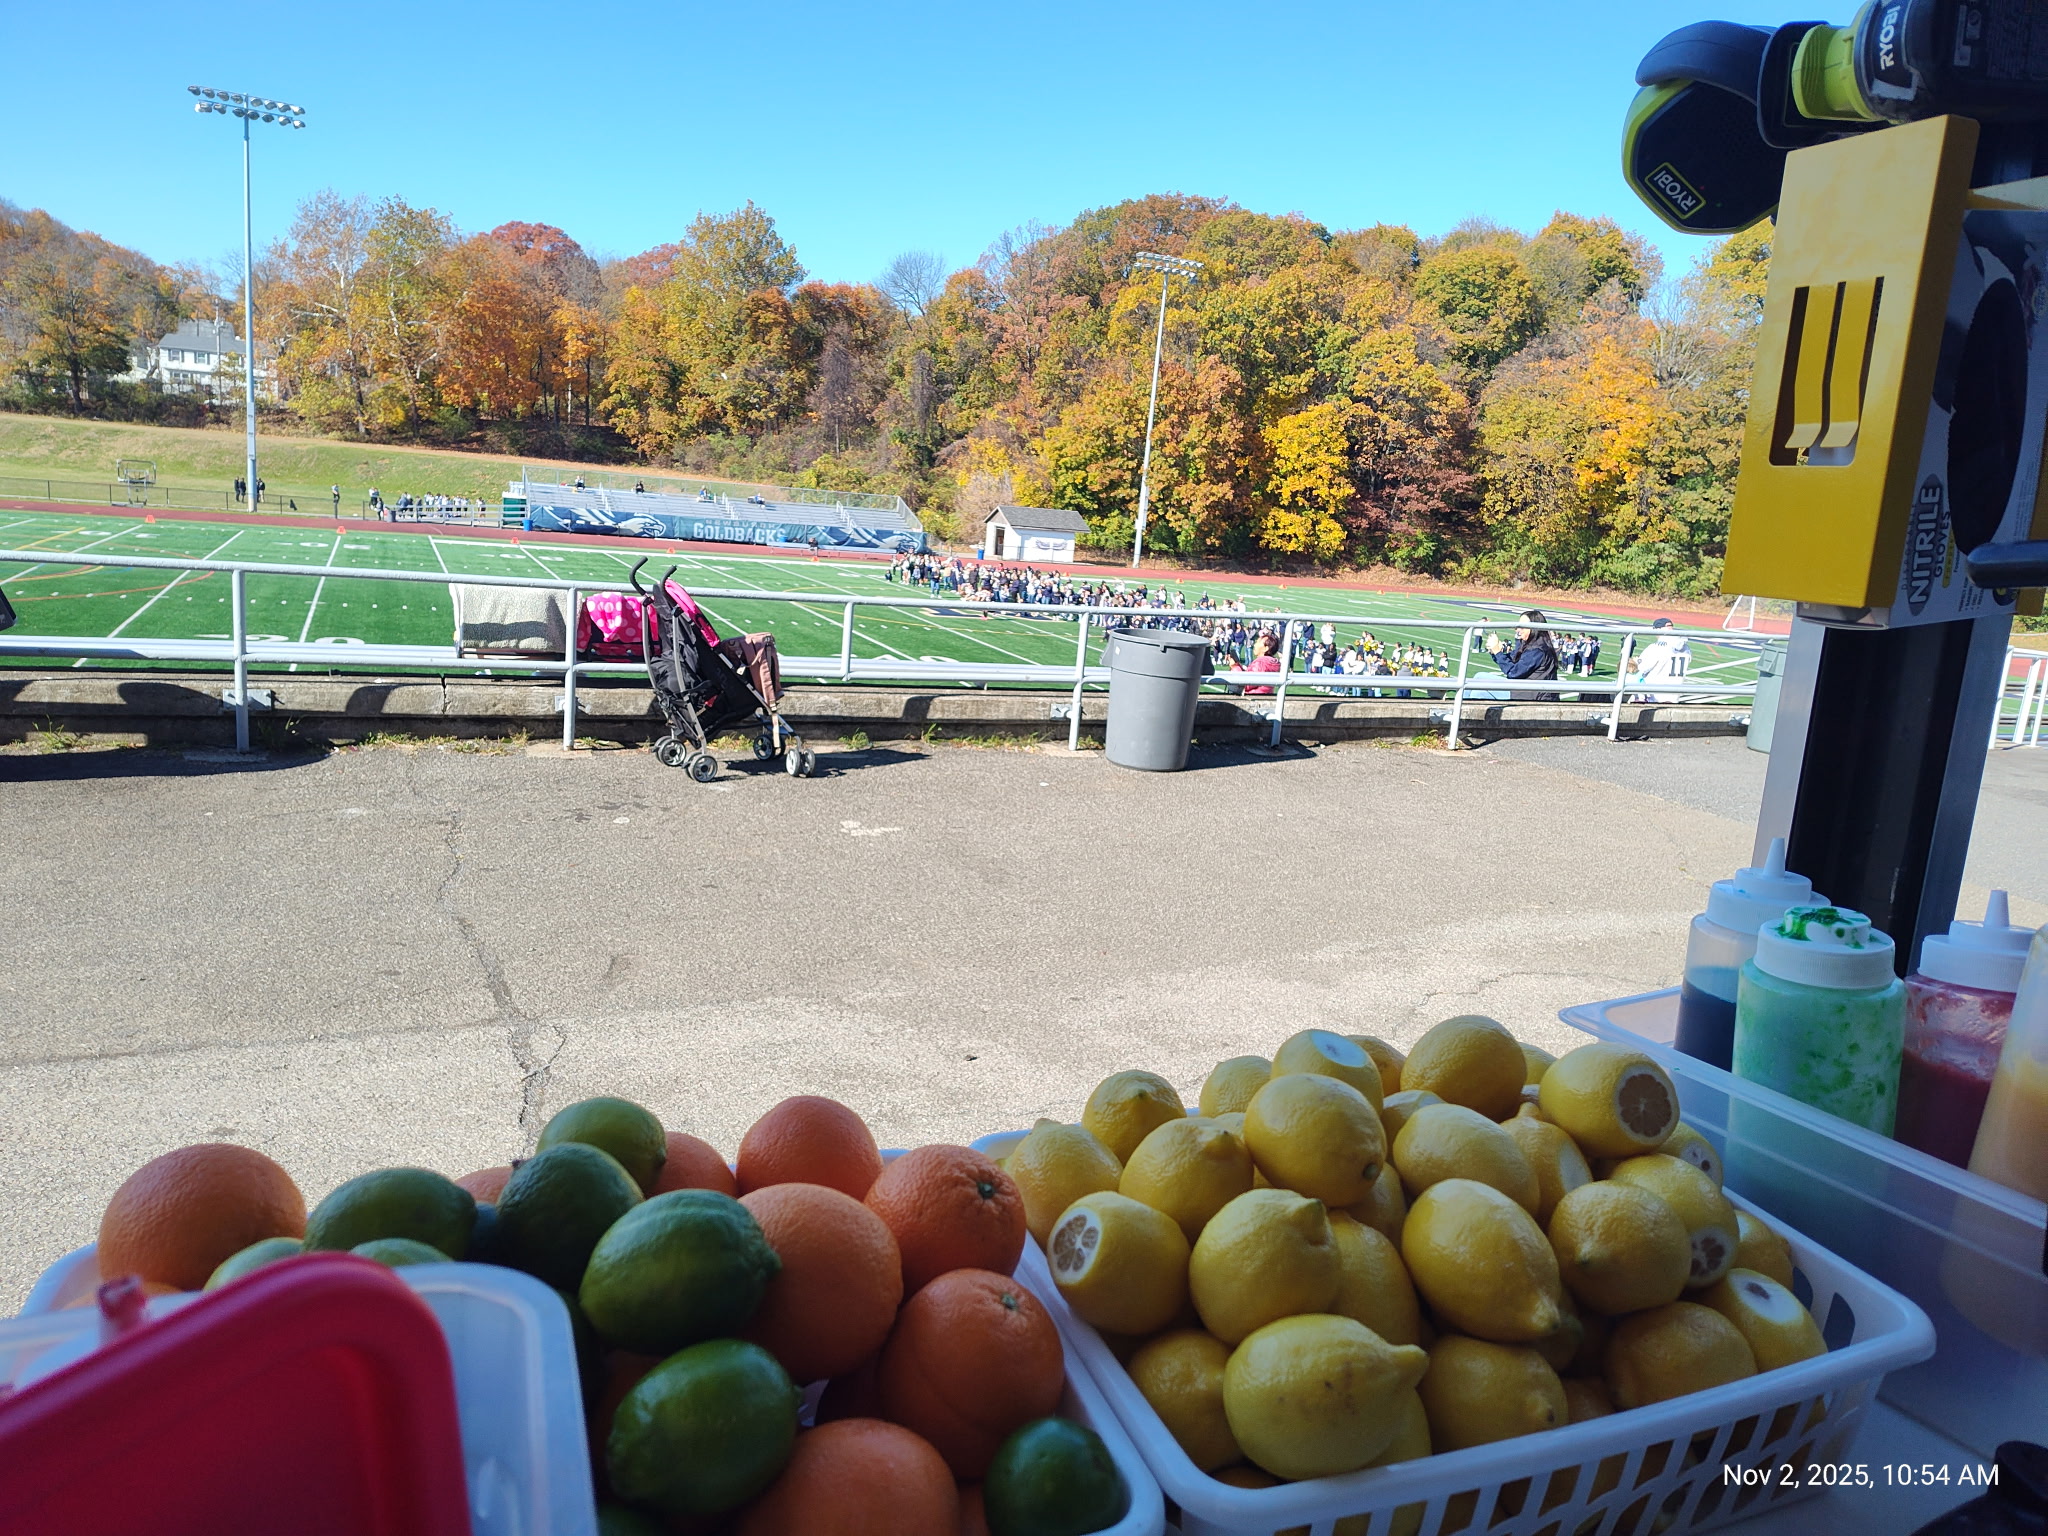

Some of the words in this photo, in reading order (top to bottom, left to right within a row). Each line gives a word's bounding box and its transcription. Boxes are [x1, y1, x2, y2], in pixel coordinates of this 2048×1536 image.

[1880, 5, 1901, 70] RYOBI
[1653, 170, 1696, 212] RYOBI
[693, 522, 786, 544] GOLDBACKS
[1909, 487, 1941, 603] NITRILE
[1934, 511, 1951, 578] GLOVES
[1668, 656, 1685, 677] 11
